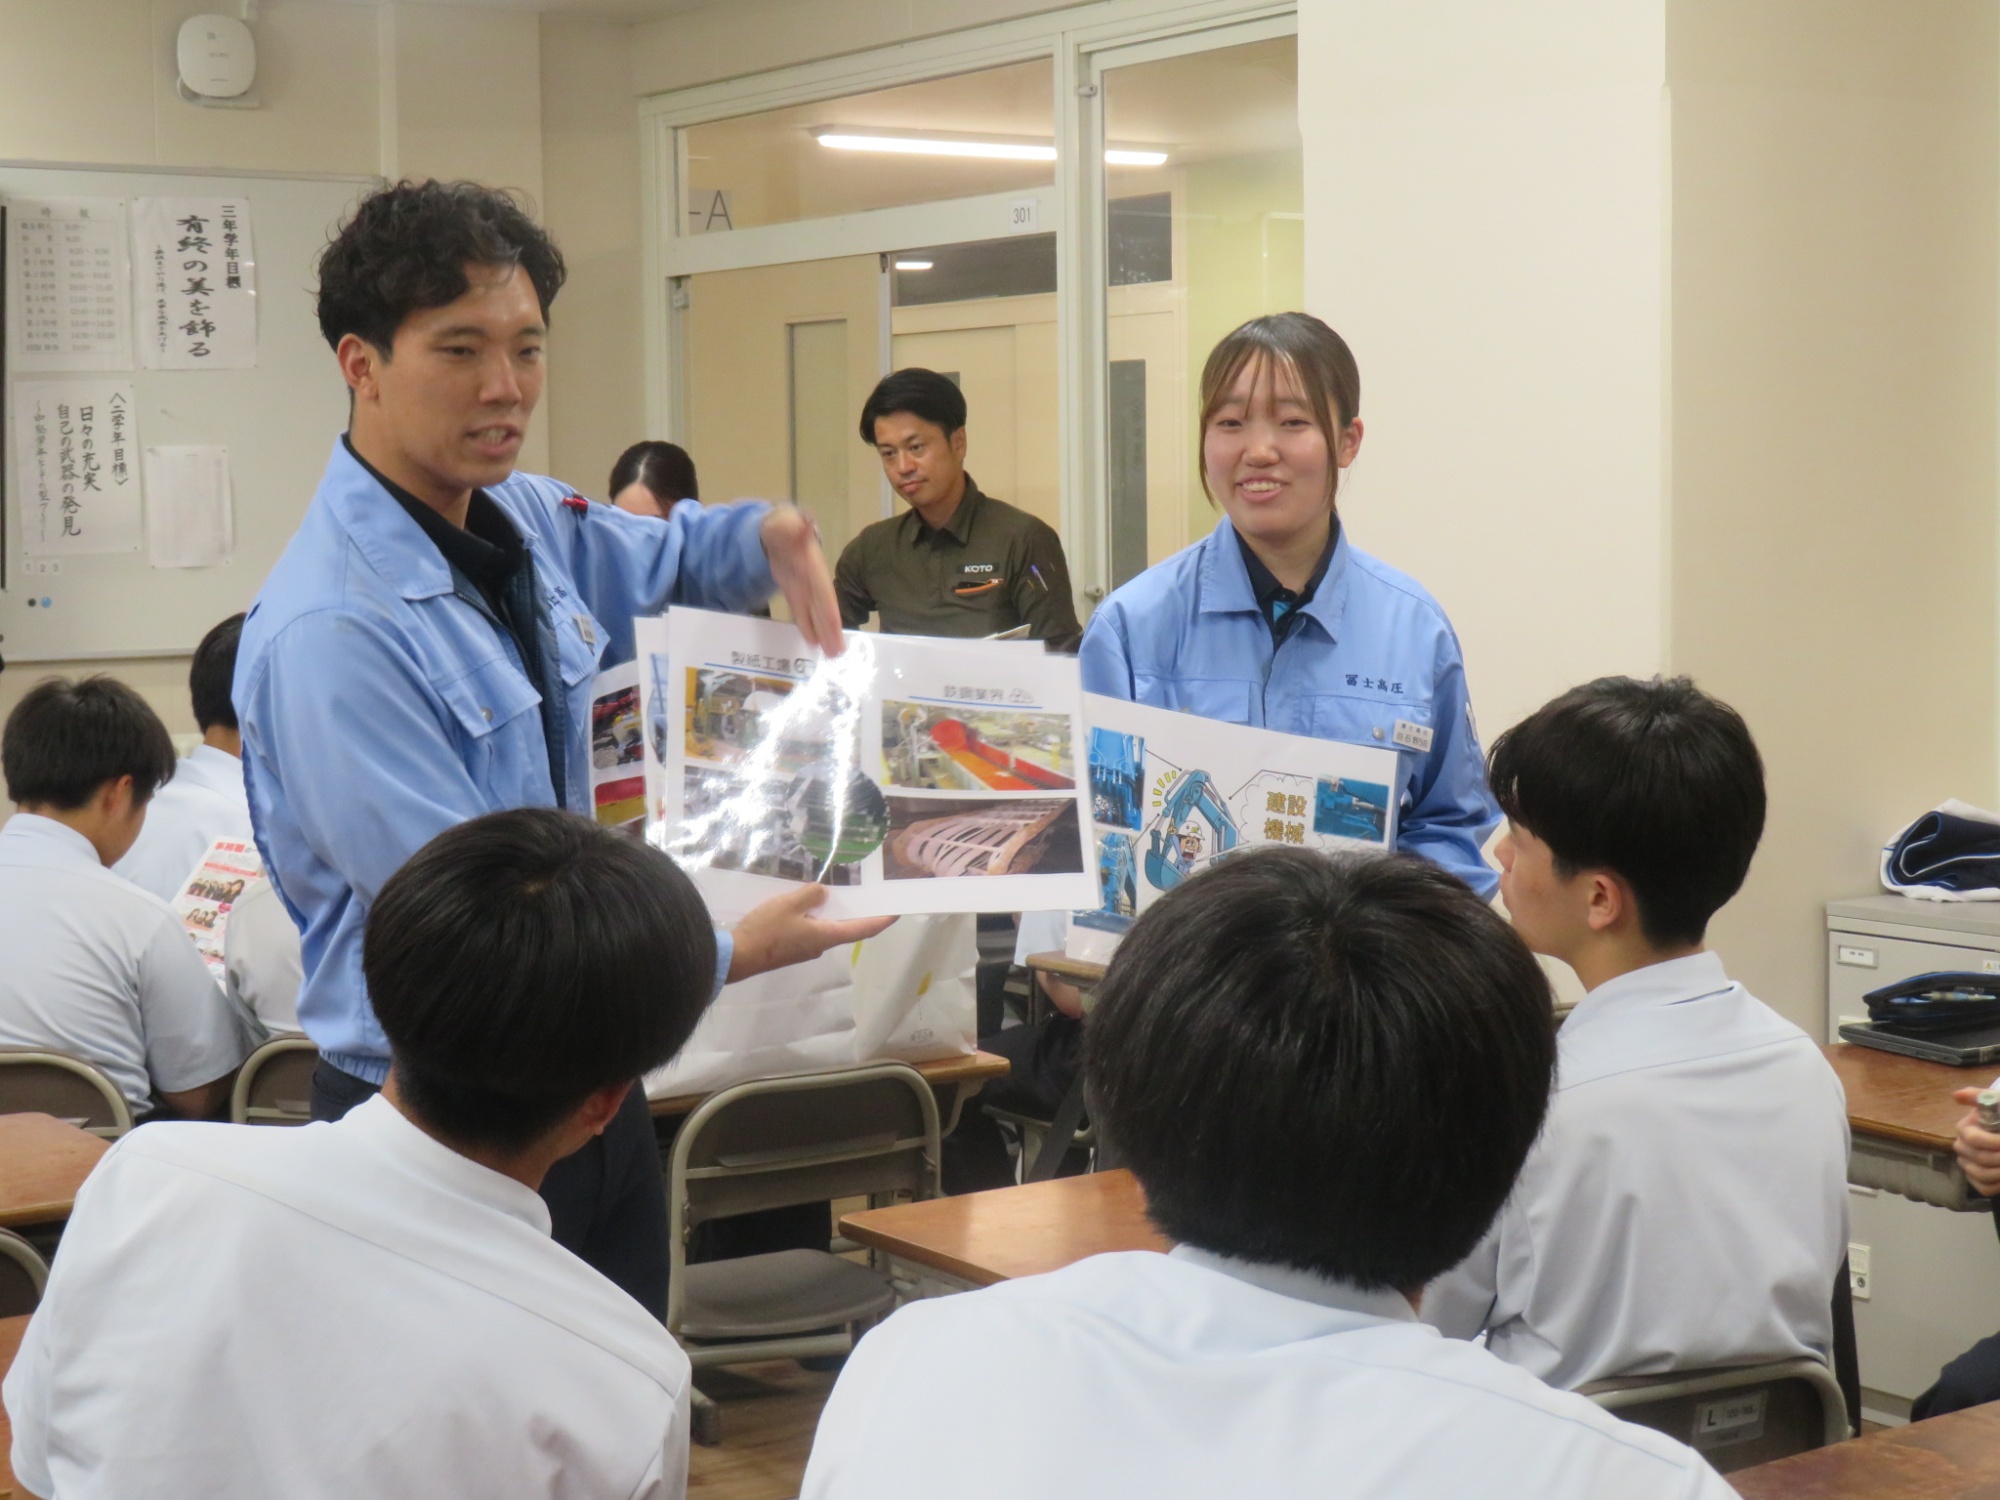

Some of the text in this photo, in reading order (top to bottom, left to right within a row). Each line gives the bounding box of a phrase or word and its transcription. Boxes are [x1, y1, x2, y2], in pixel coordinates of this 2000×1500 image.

[1013, 206, 1031, 224] 301
[176, 214, 217, 358] 有終の美を飾る
[80, 405, 102, 492] 日々の充実
[57, 403, 82, 537] 自己の武器の発見
[964, 564, 993, 573] KOTO
[1266, 791, 1307, 817] 建設
[1264, 817, 1305, 845] 機械
